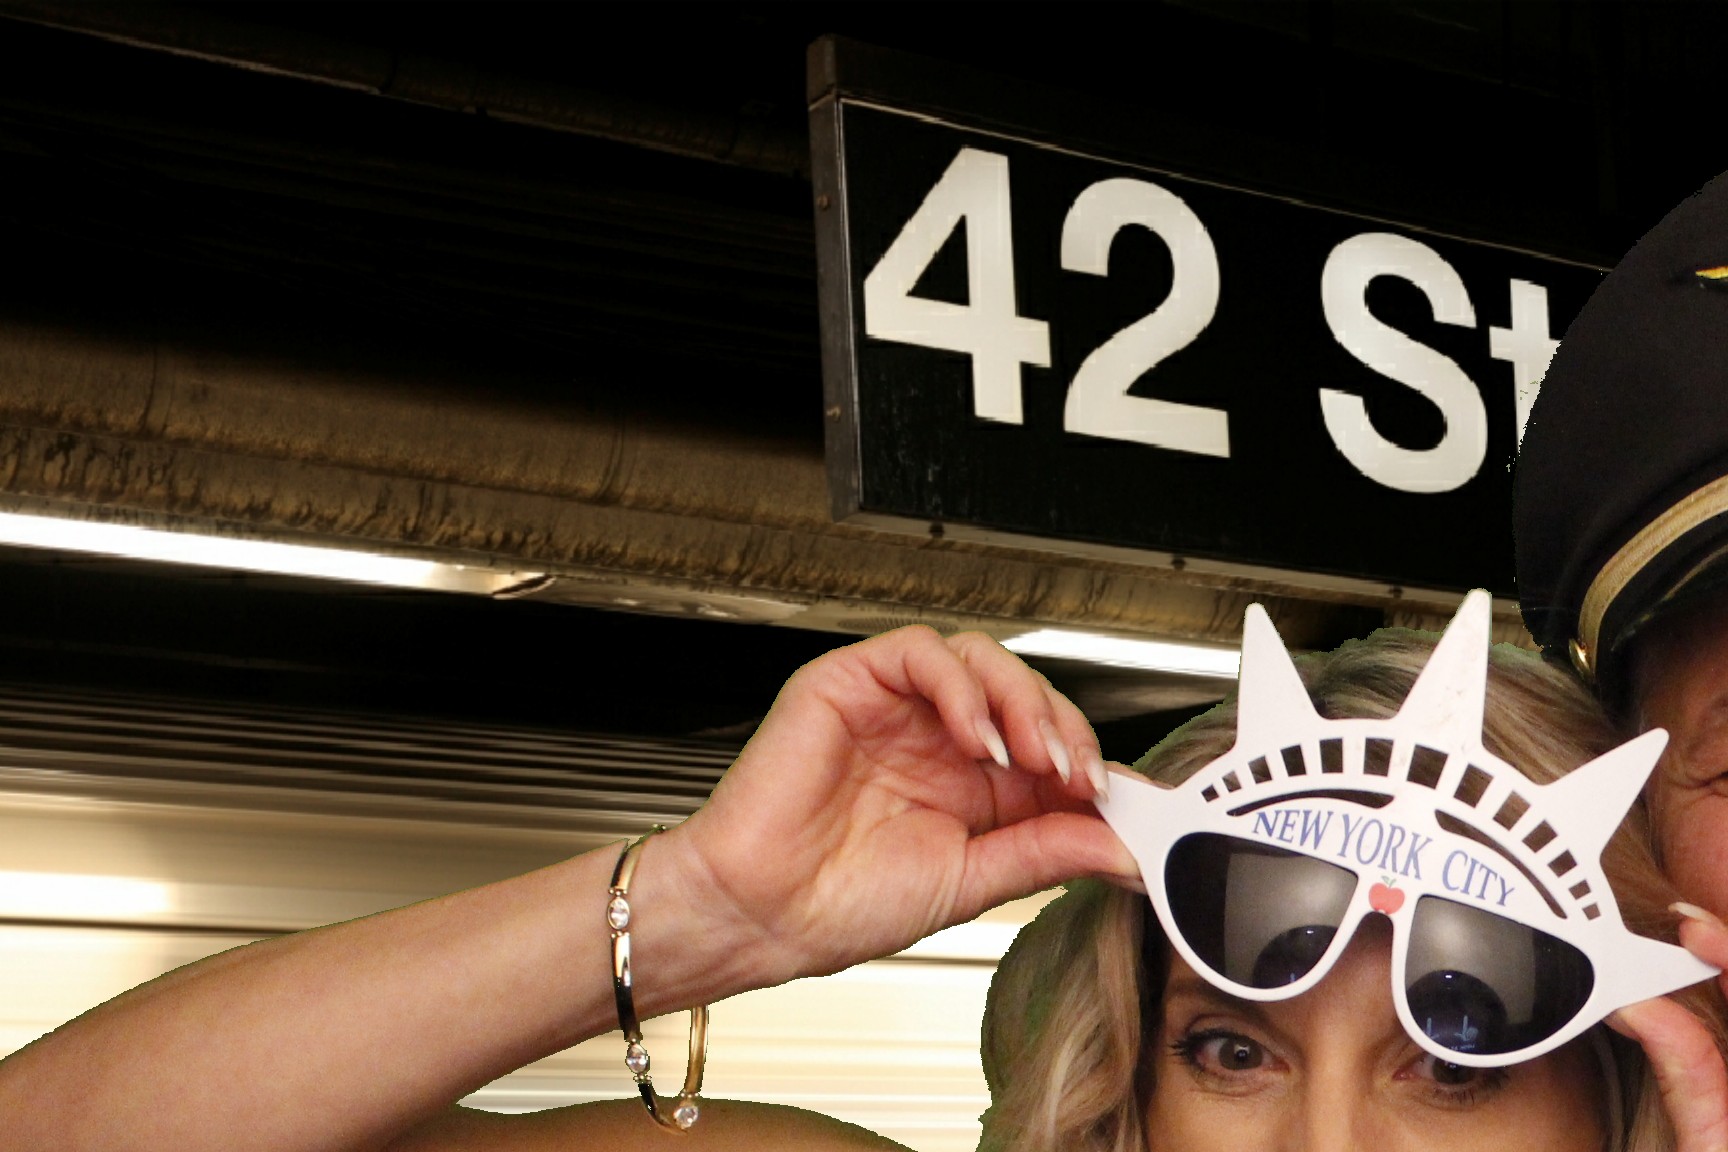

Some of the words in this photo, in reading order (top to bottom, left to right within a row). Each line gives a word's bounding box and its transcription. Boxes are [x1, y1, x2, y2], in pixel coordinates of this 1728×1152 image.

[863, 147, 1230, 458] 42
[1252, 809, 1334, 850] NEW
[1336, 813, 1433, 880] YORK
[1442, 850, 1516, 906] CITY
